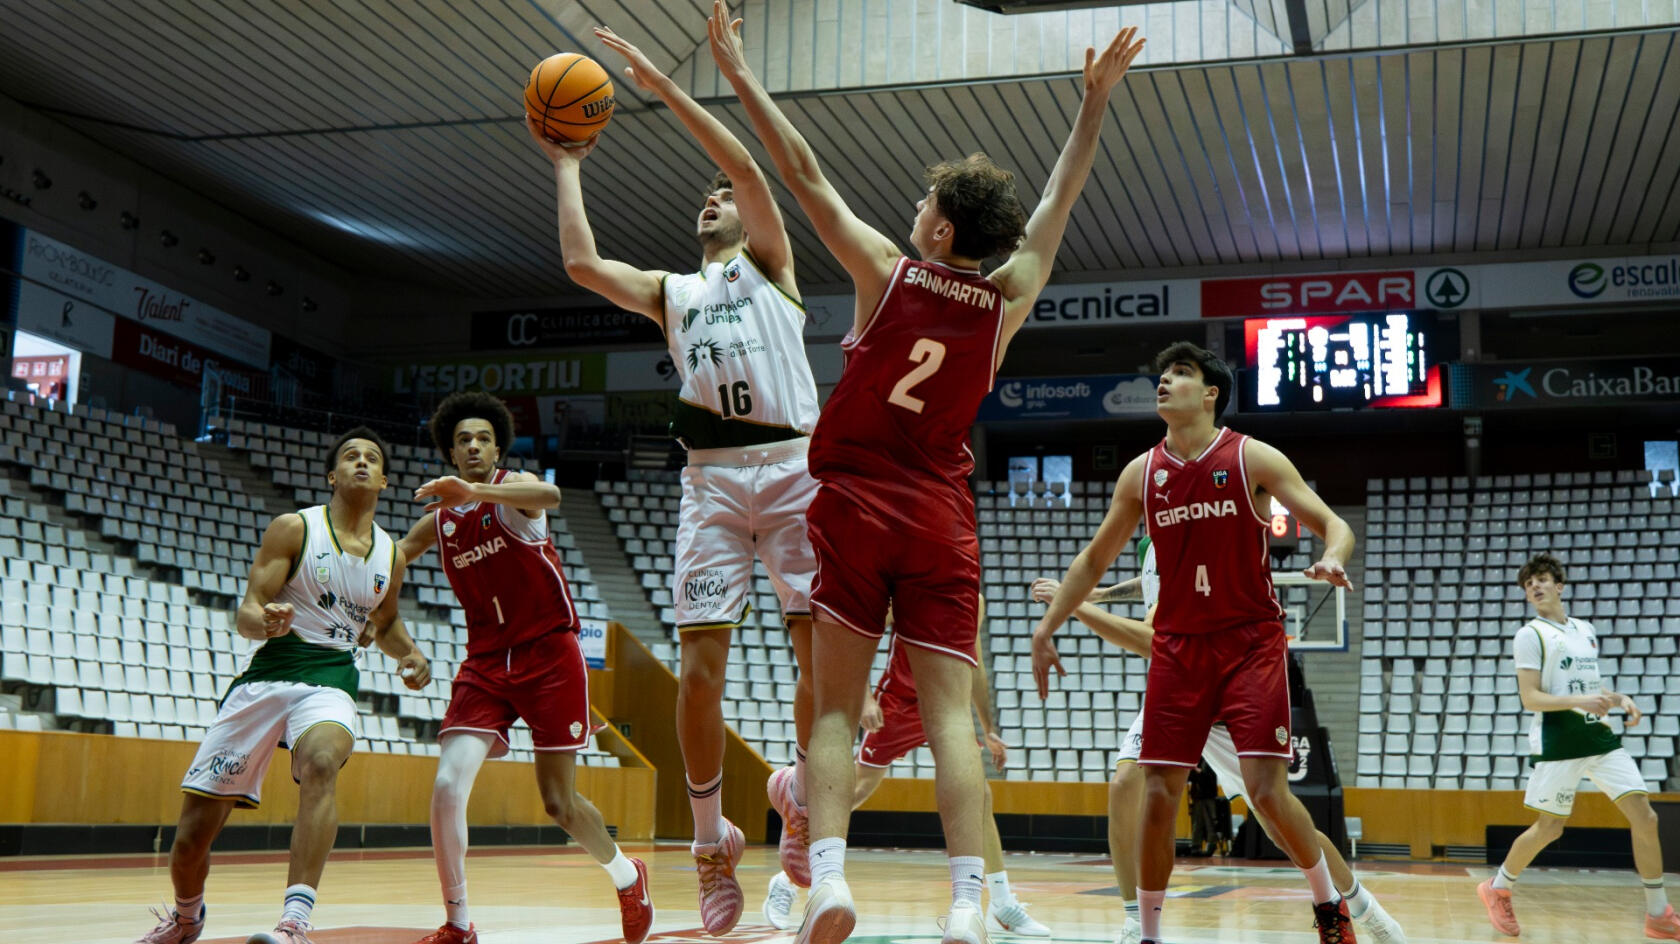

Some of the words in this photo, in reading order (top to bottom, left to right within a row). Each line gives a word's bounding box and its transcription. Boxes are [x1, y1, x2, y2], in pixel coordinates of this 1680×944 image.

[903, 266, 996, 311] SANMARTIN
[1612, 259, 1680, 286] escal
[134, 286, 190, 321] Valent
[1026, 285, 1169, 322] ecnical
[1260, 277, 1412, 309] SPAR
[138, 332, 180, 367] Diari
[181, 350, 201, 374] de
[393, 360, 582, 394] L'ESPORTIU
[887, 337, 946, 415] 2
[1026, 382, 1091, 399] infosoft
[718, 380, 753, 418] 16
[1154, 500, 1238, 528] GIRONA
[1194, 564, 1212, 597] 4
[492, 595, 505, 625] 1
[689, 601, 722, 610] DENTAL
